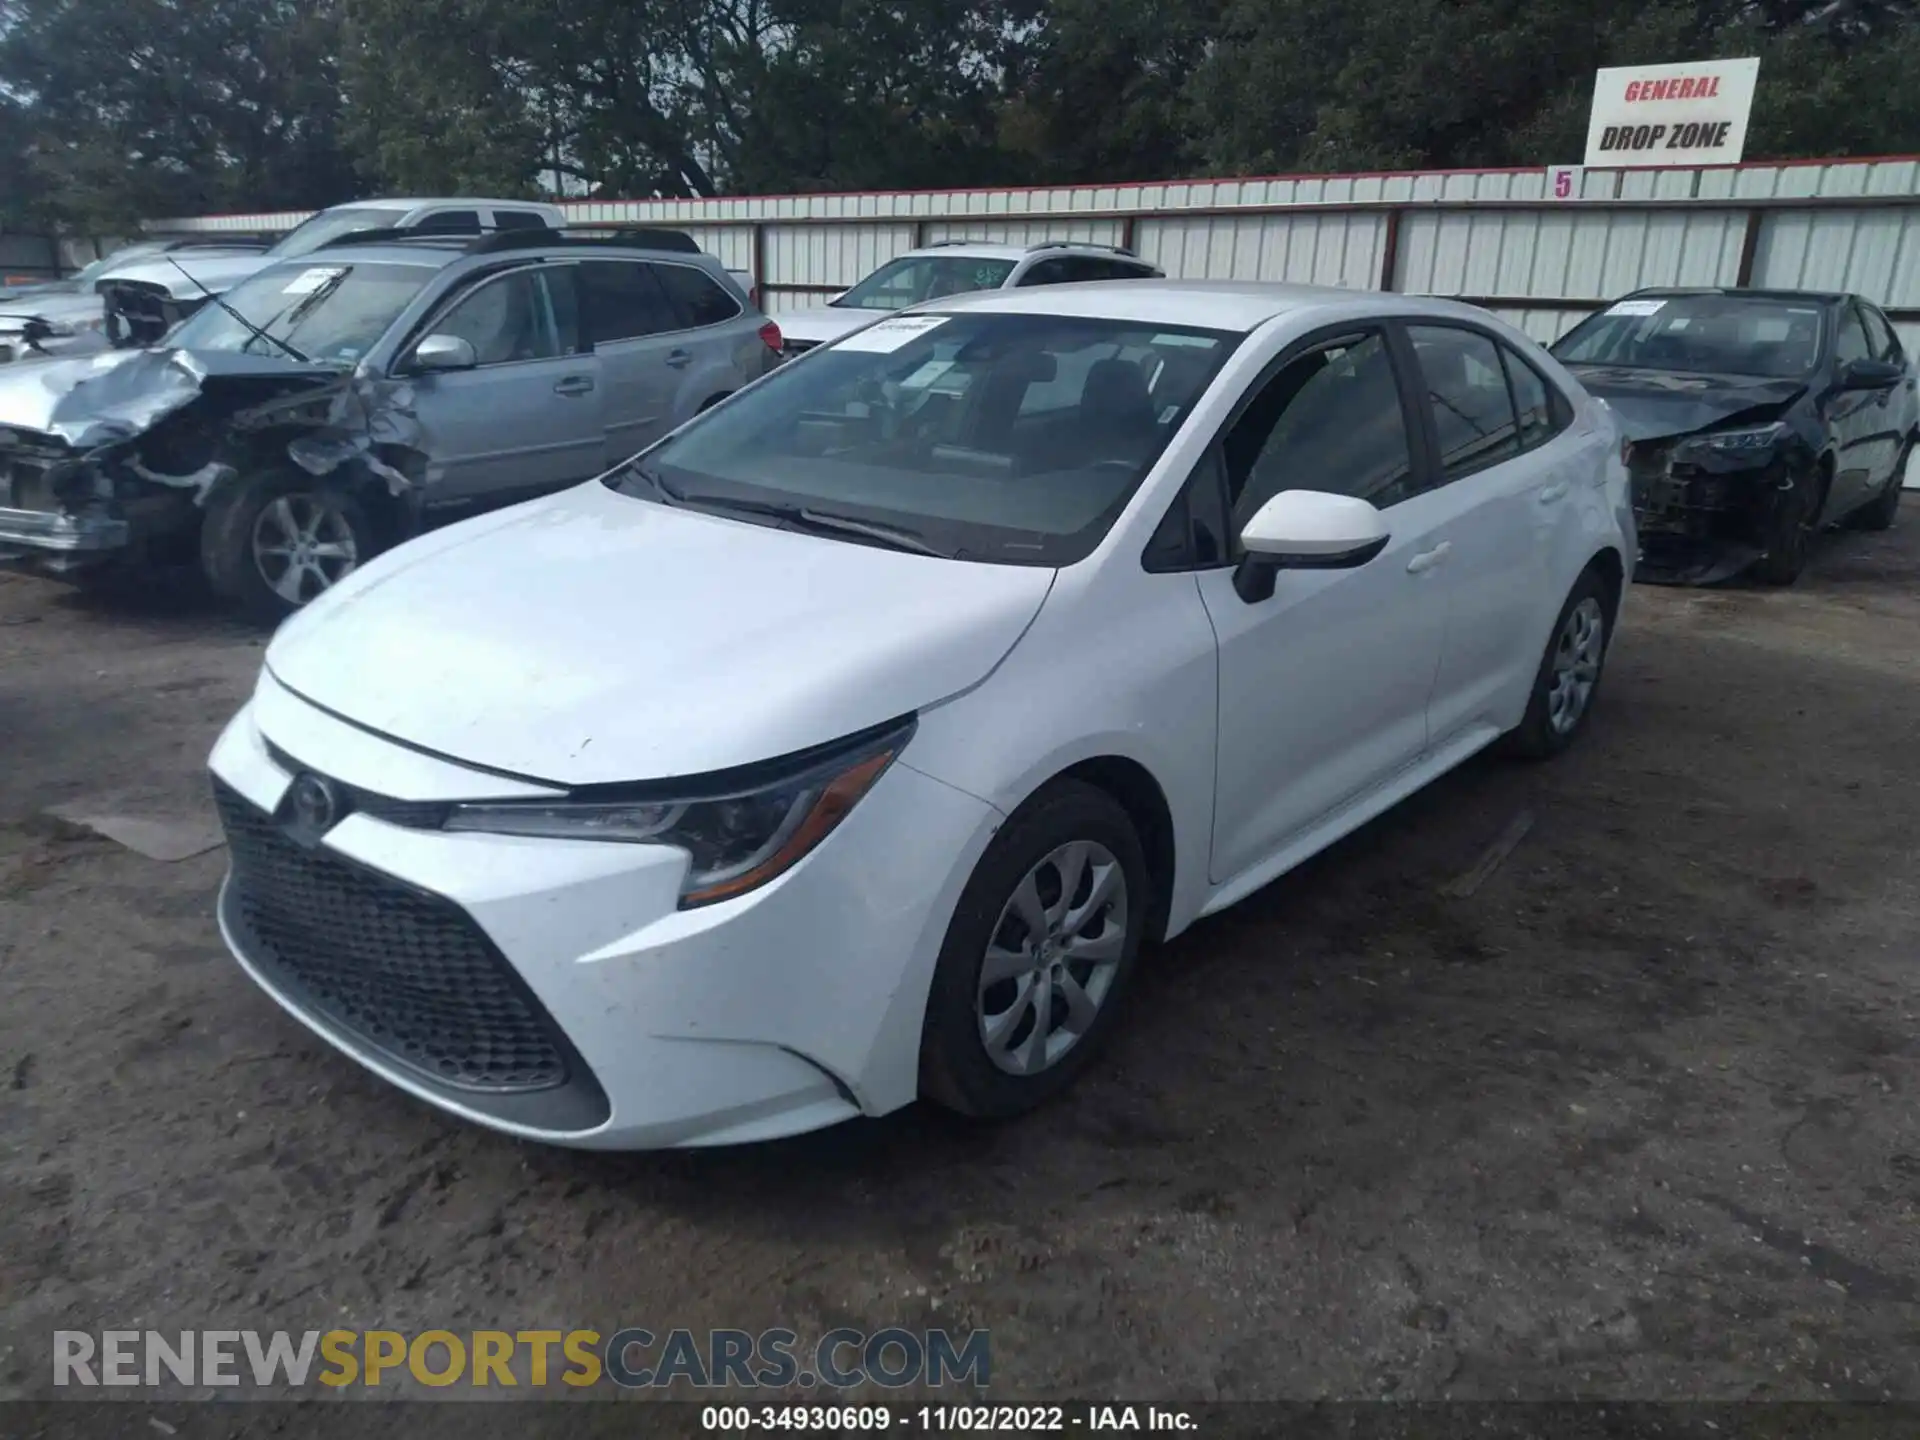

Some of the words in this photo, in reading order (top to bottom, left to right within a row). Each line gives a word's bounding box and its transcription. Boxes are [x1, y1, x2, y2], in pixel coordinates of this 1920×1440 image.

[1624, 76, 1720, 102] GENERAL
[1599, 124, 1666, 151] DROP
[1666, 121, 1732, 149] ZONE
[1555, 171, 1572, 198] 5
